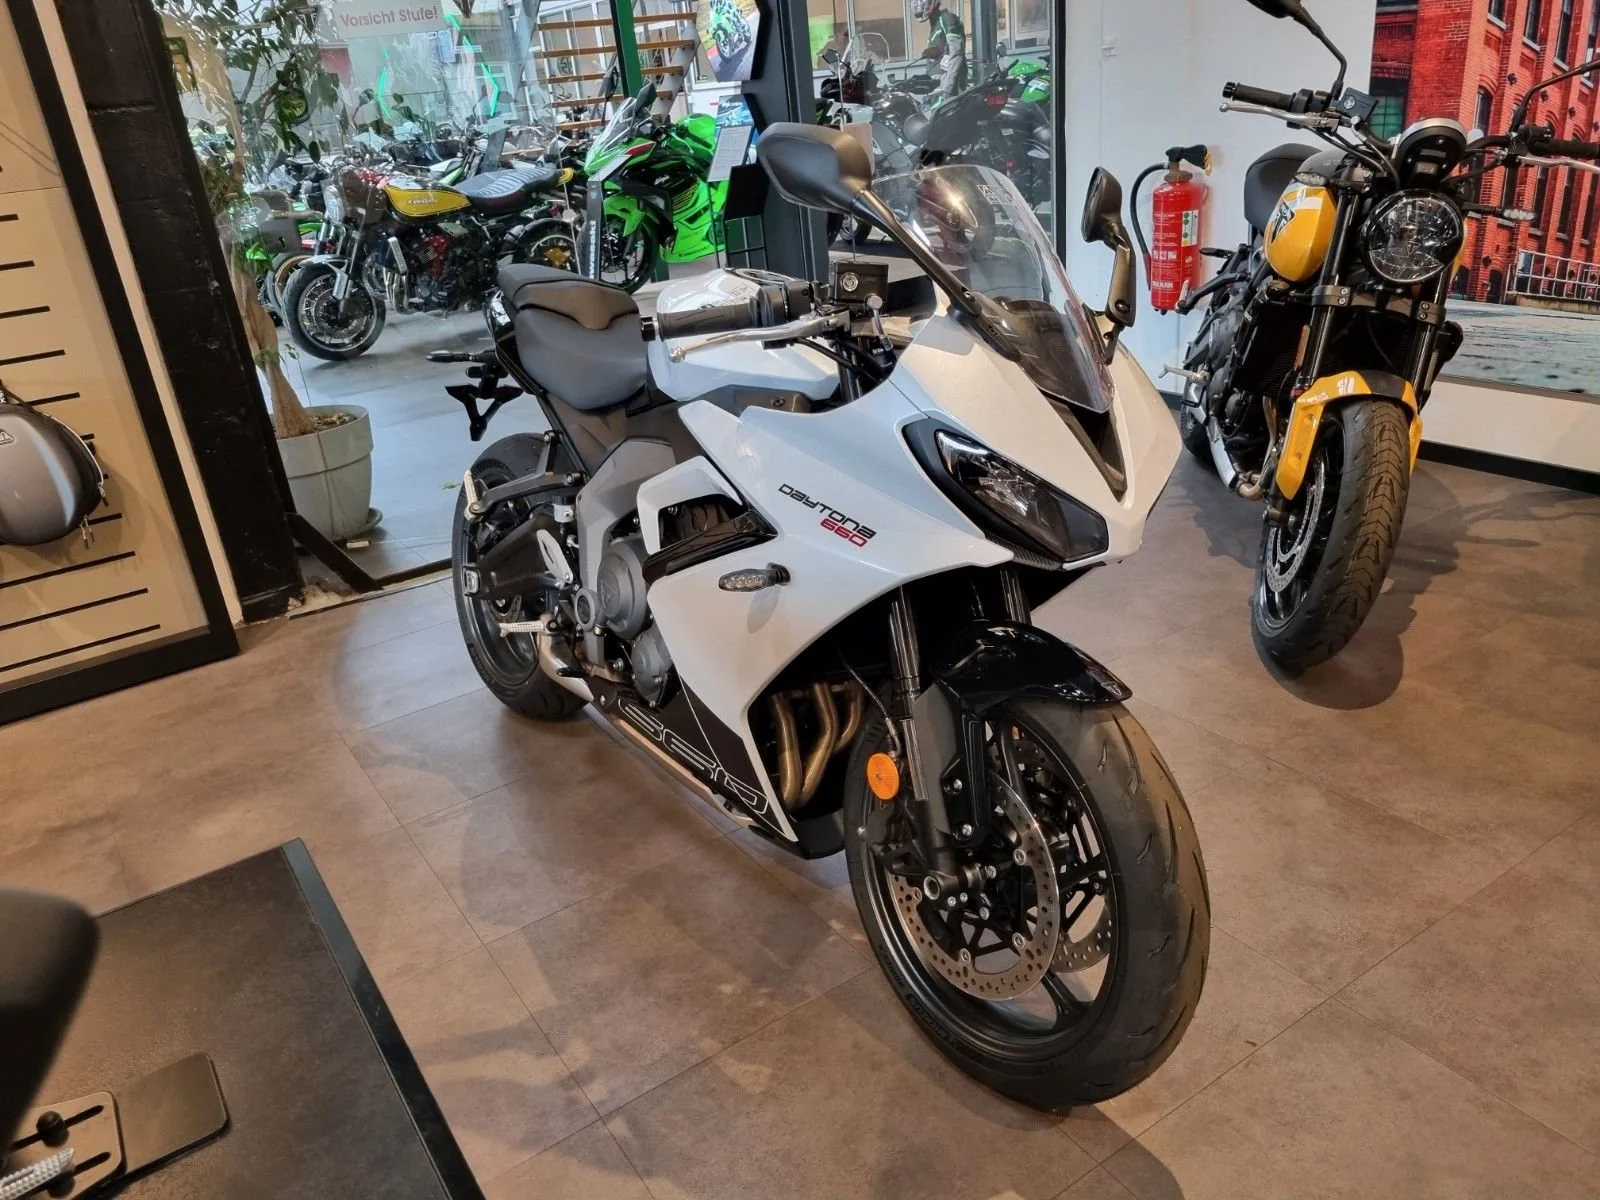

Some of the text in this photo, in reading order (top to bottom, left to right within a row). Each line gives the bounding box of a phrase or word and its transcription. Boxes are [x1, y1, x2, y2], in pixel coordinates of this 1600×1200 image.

[340, 5, 439, 28] Vorsicht Stufe!
[820, 518, 868, 547] 660
